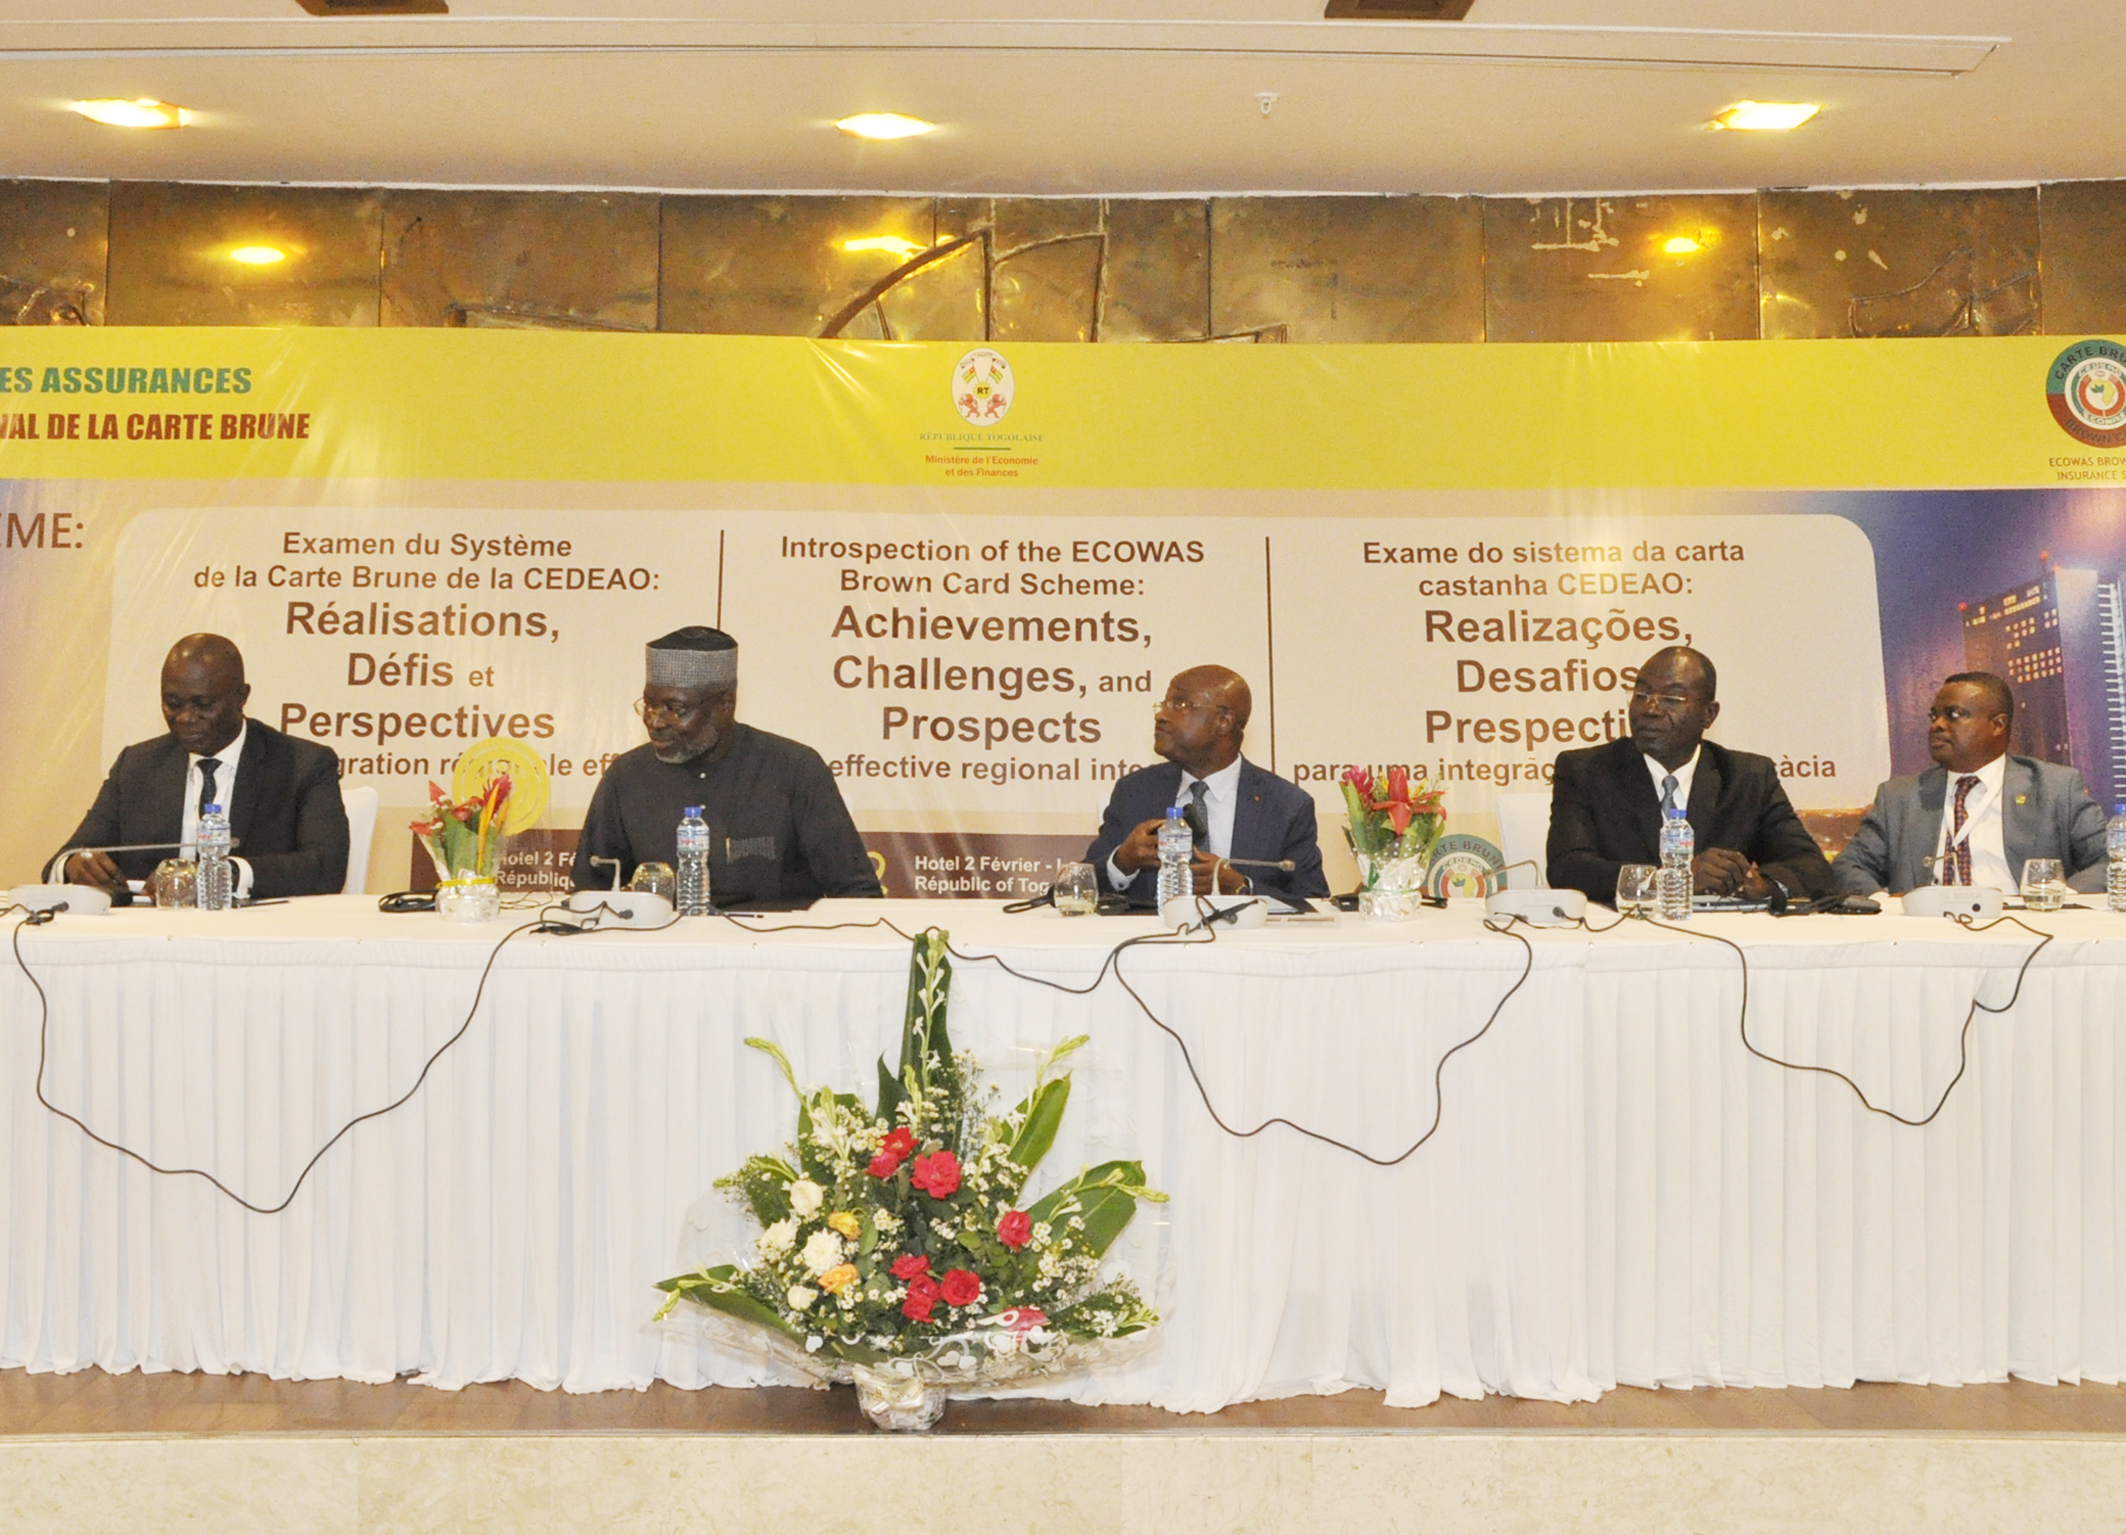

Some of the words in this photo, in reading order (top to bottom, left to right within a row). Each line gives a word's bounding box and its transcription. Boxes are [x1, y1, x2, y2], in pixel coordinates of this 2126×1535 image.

[2054, 346, 2094, 381] CARTE
[41, 367, 252, 394] ASSURANCES
[977, 386, 990, 396] RT
[47, 413, 81, 440] DE
[88, 413, 119, 440] LA
[126, 413, 213, 440] CARTE
[220, 413, 310, 440] BRUNE
[919, 431, 983, 442] RÉPUBLIQUE
[984, 433, 1045, 442] TOGOLAISE
[925, 455, 970, 465] Ministère
[972, 455, 985, 465] de
[945, 468, 955, 477] et
[957, 468, 974, 477] des
[976, 468, 1019, 478] Finances
[2049, 457, 2094, 468] ECOWAS
[2057, 470, 2118, 481] INSURANCE
[0, 511, 84, 549] ME:
[283, 531, 396, 555] Examen
[405, 534, 440, 556] du
[450, 533, 572, 562] Système
[781, 536, 970, 565] Introspection
[980, 540, 1009, 562] of
[1017, 540, 1061, 562] the
[1071, 540, 1206, 563] ECOWAS
[1363, 541, 1458, 564] Exame
[1468, 541, 1503, 563] do
[1512, 541, 1623, 564] sistema
[1632, 540, 1667, 563] da
[1675, 541, 1745, 562] carta
[194, 565, 226, 588] de
[235, 565, 258, 588] la
[267, 565, 343, 589] Carte
[352, 565, 437, 589] Brune
[446, 567, 481, 590] de
[490, 567, 514, 590] la
[523, 567, 660, 591] CEDEAO:
[840, 569, 933, 594] Brown
[942, 571, 1010, 595] Card
[1019, 572, 1145, 596] Scheme:
[1418, 573, 1549, 597] castanha
[1556, 572, 1694, 596] CEDEAO:
[286, 600, 560, 643] Réalisations,
[831, 604, 1152, 648] Achievements,
[1424, 607, 1693, 650] Realizações,
[347, 651, 454, 688] Défis
[468, 665, 495, 688] et
[832, 654, 1088, 700] Challenges,
[1098, 669, 1152, 693] and
[1456, 658, 1639, 693] Desafios
[280, 702, 556, 746] Perspectives
[882, 706, 1102, 750] Prospects
[829, 753, 952, 779] effective
[961, 756, 1080, 786] regional
[543, 850, 554, 866] 2
[914, 855, 960, 871] Hotel
[964, 855, 975, 871] 2
[980, 855, 1041, 872] Février
[914, 875, 992, 895] Républic
[995, 877, 1014, 892] of
